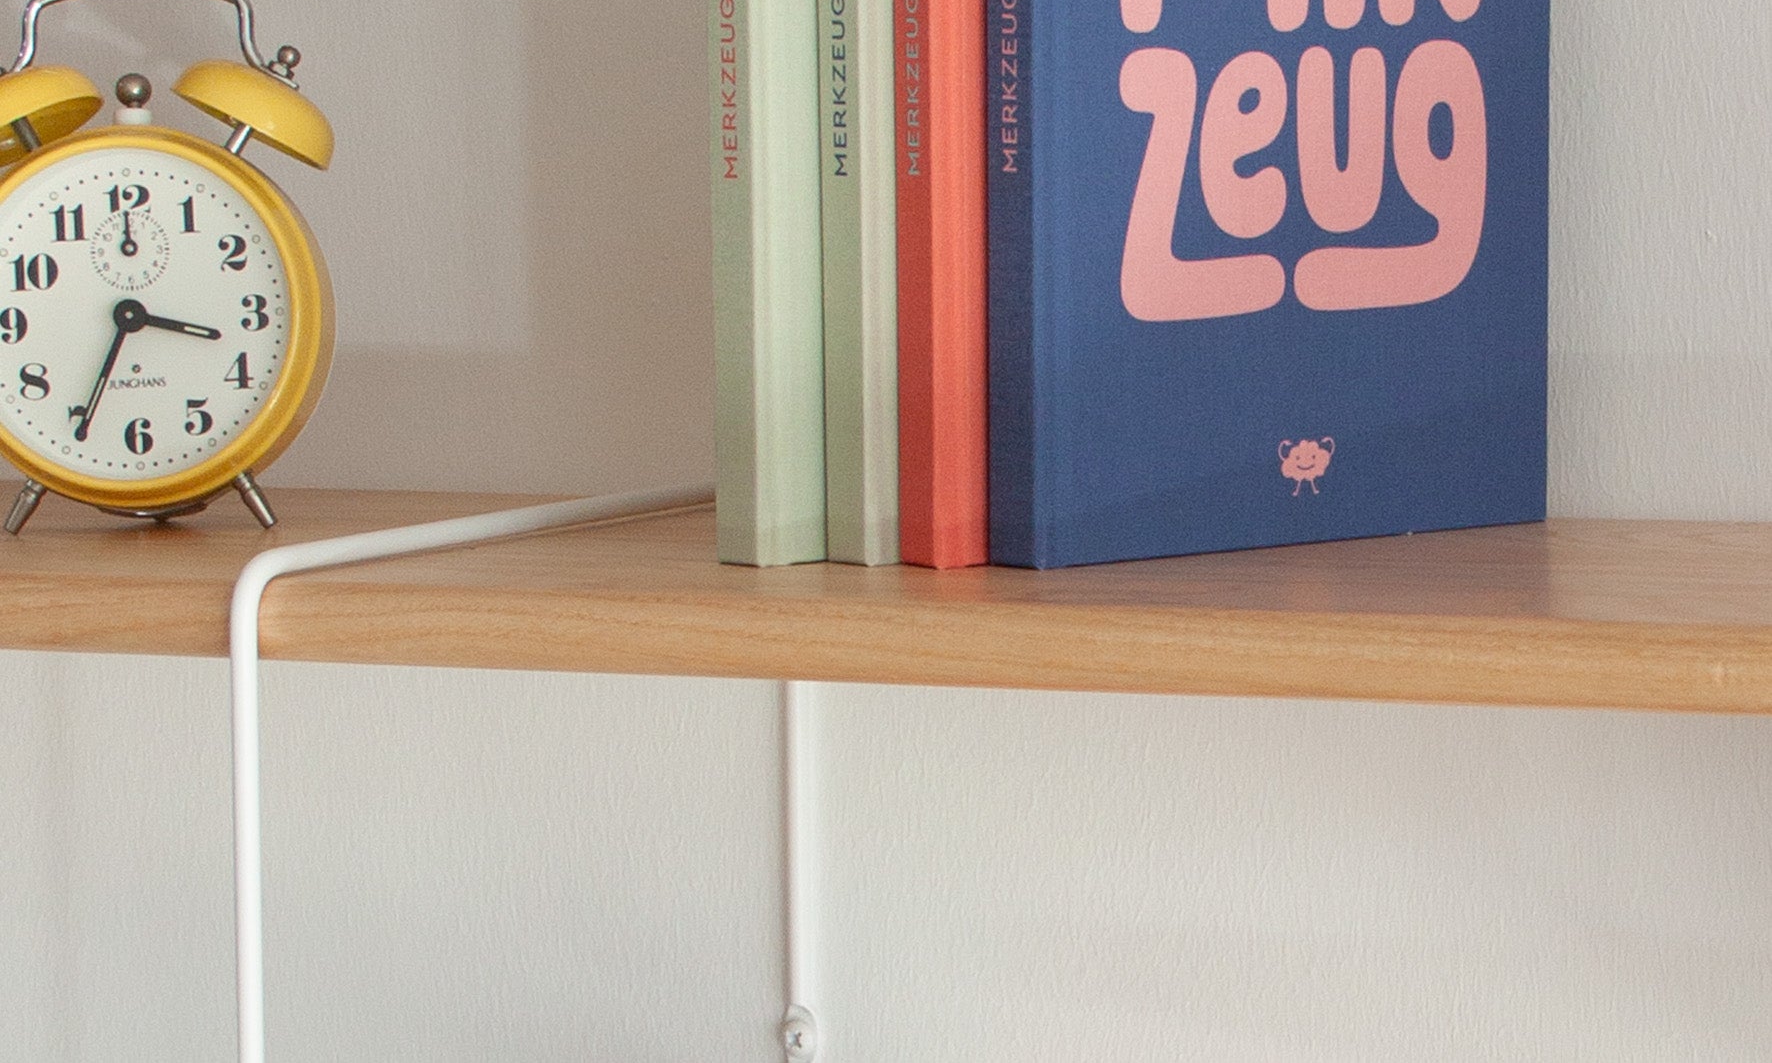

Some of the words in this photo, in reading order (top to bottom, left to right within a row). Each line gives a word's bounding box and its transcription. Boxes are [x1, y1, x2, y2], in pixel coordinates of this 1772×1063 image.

[103, 184, 151, 213] 12
[178, 196, 200, 234] 1
[49, 203, 89, 242] 11
[218, 234, 247, 271] 2
[9, 253, 59, 291] 10
[0, 307, 28, 344] 9
[241, 294, 269, 331] 3
[19, 363, 50, 400] 8
[108, 377, 166, 390] JUNGHANS
[224, 352, 254, 389] 4
[184, 397, 213, 435] 5
[124, 417, 153, 455] 6
